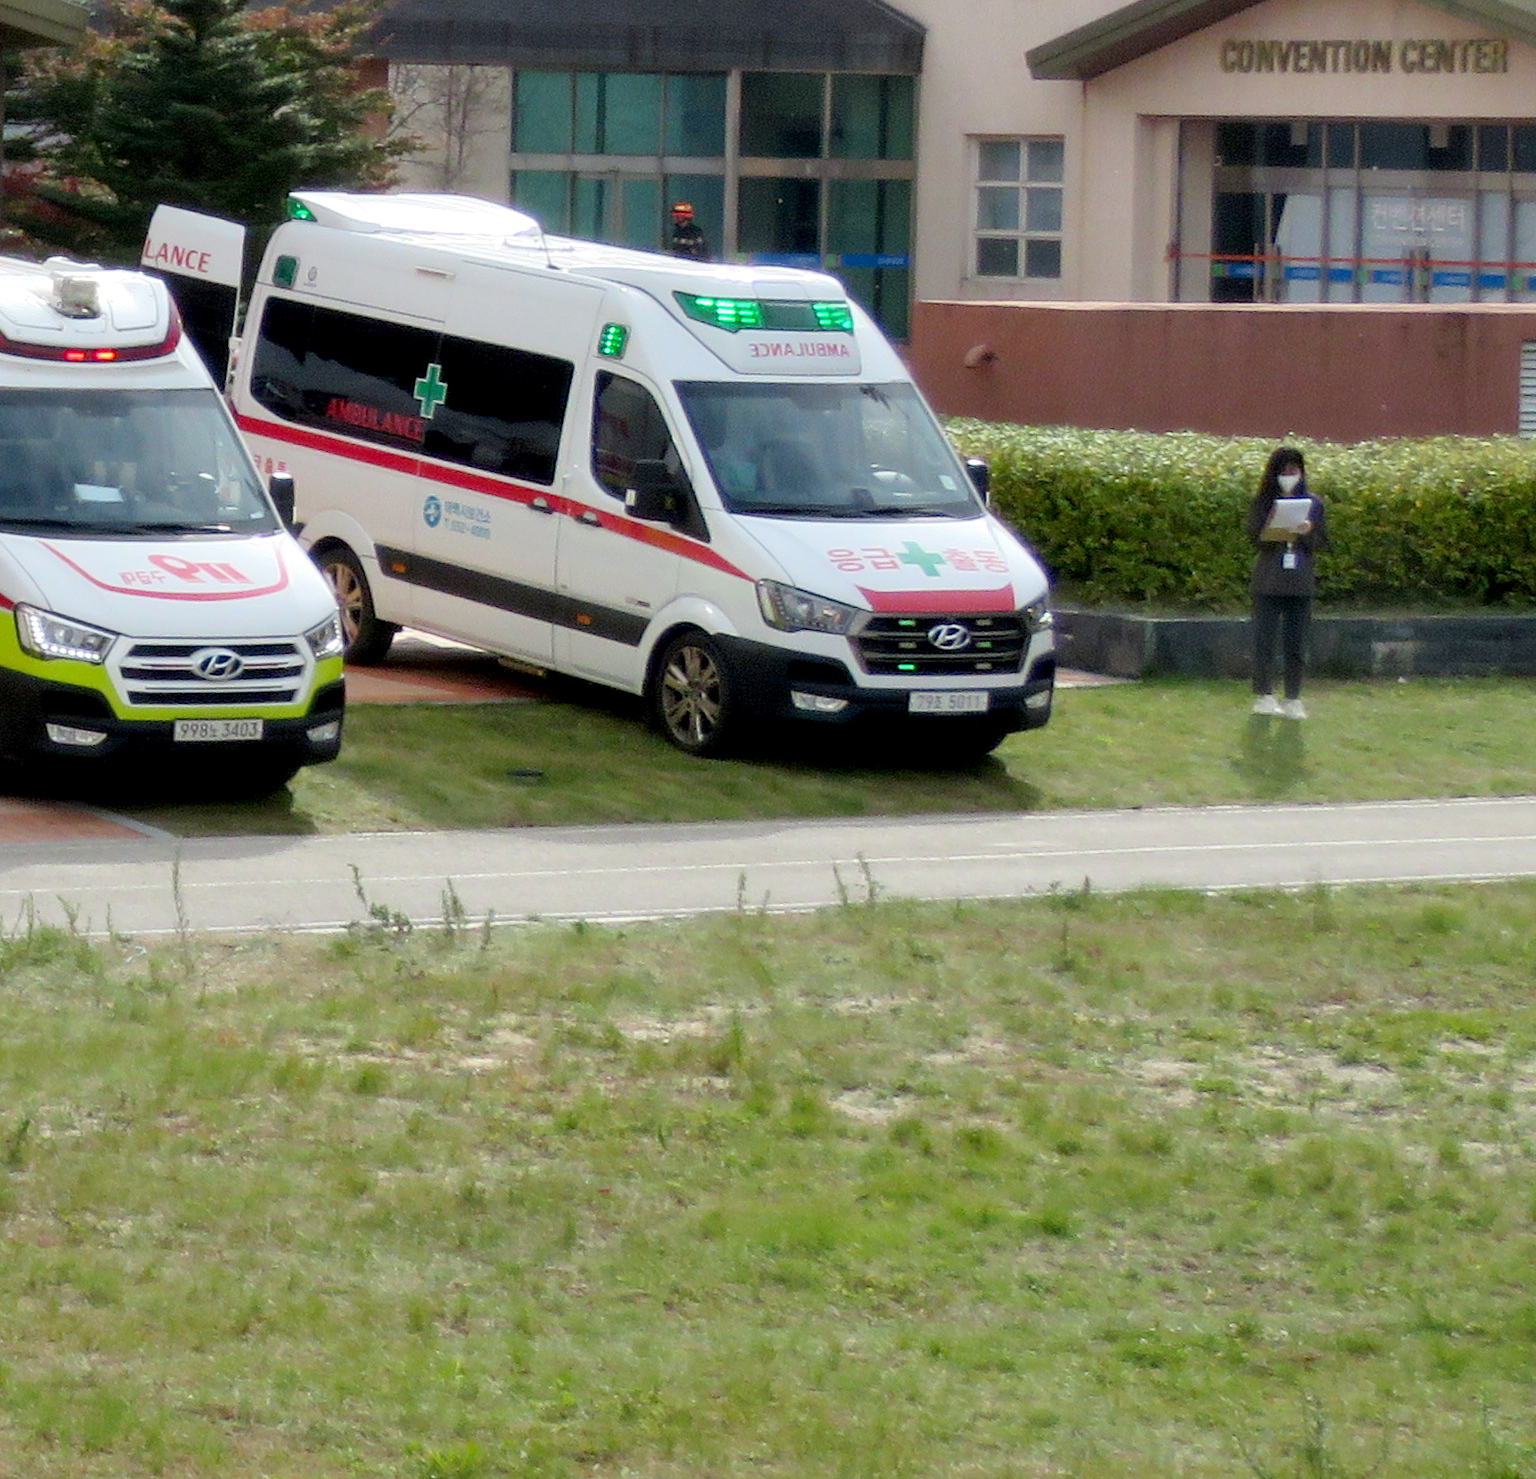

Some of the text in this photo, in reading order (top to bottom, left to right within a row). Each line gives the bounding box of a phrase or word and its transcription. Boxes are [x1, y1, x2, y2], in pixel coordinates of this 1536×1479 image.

[1221, 39, 1508, 73] CONVENTION CENTER
[143, 239, 212, 273] LANCE
[221, 722, 258, 738] 3403
